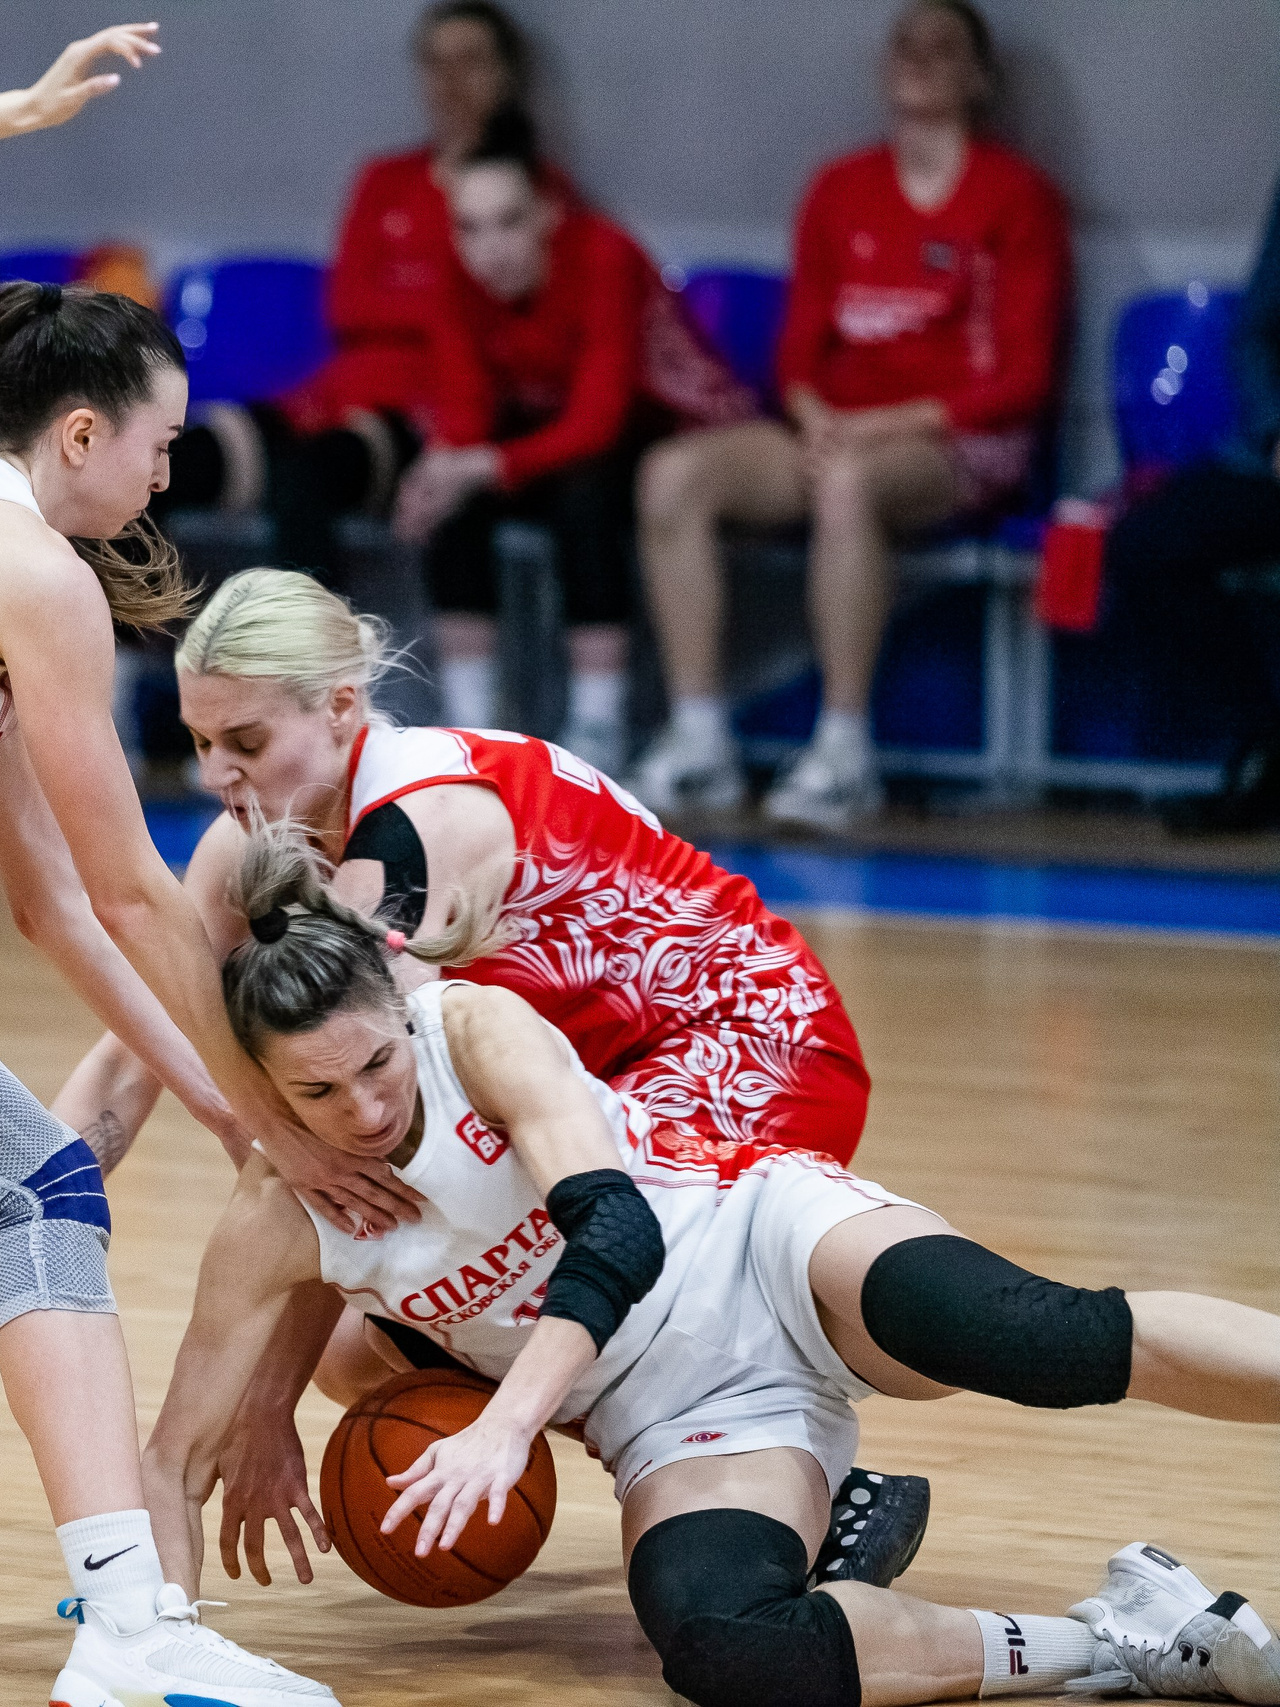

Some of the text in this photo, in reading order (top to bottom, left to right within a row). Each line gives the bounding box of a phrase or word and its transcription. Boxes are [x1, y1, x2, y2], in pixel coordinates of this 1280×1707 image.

[399, 1207, 551, 1323] СПАРТА
[431, 1260, 532, 1326] ОСКОВСКАЯ
[992, 1611, 1030, 1676] FIL
